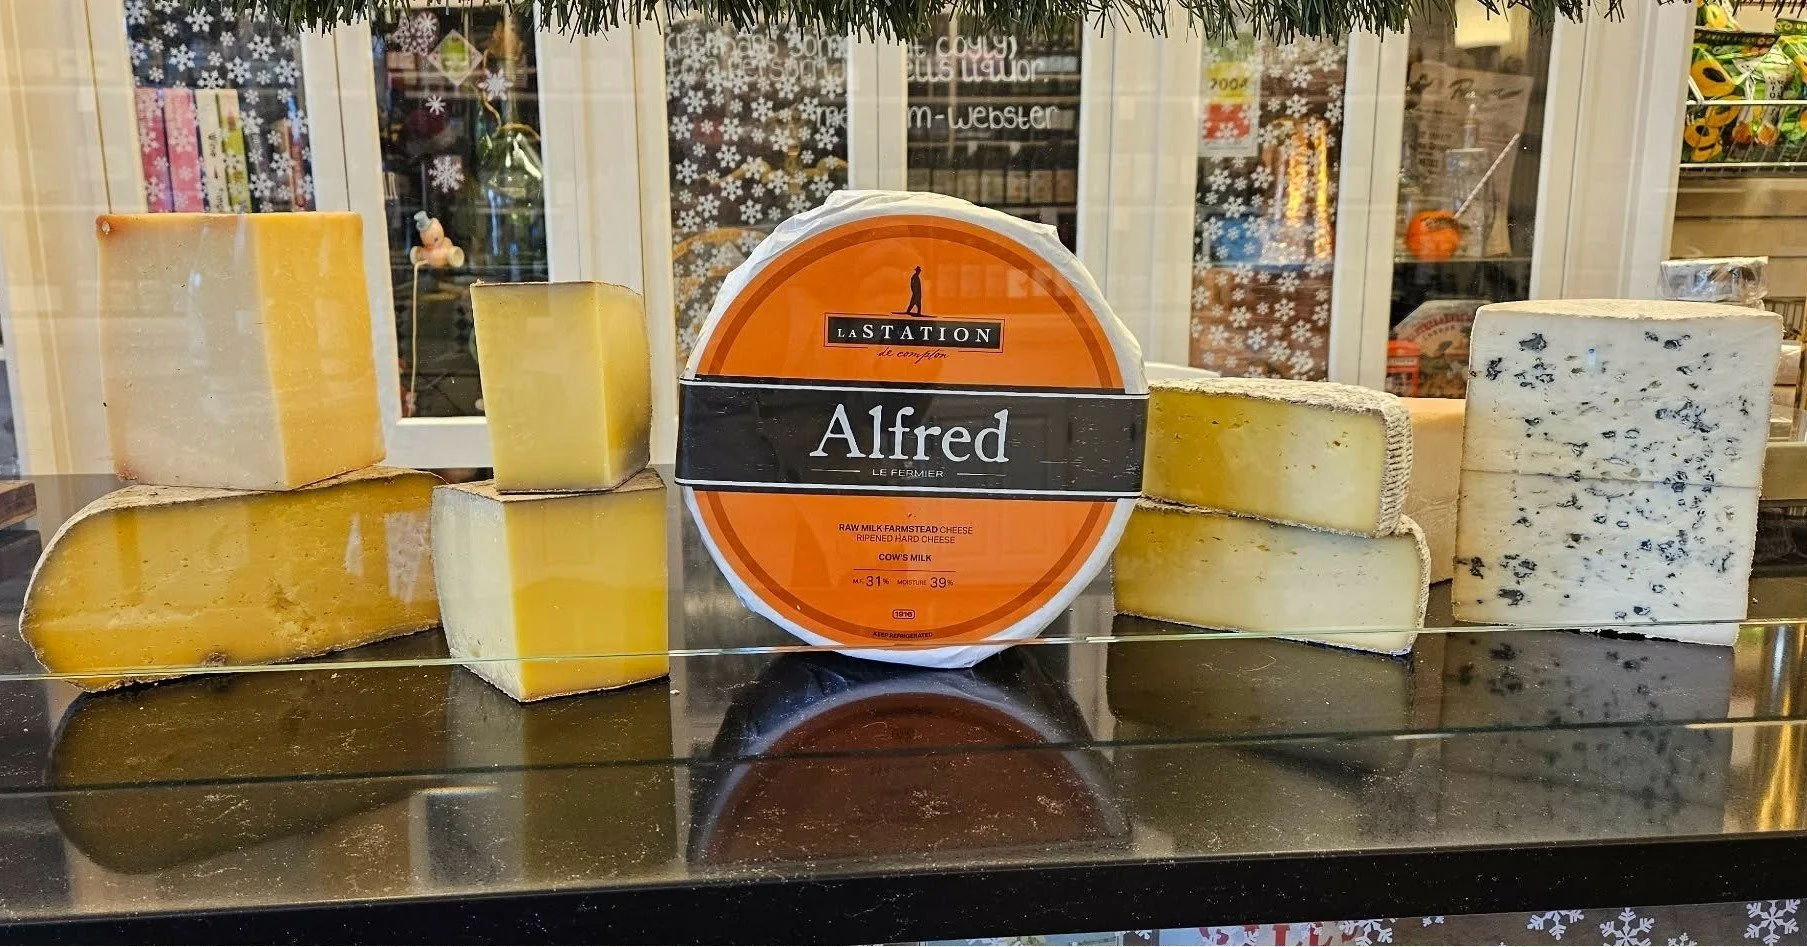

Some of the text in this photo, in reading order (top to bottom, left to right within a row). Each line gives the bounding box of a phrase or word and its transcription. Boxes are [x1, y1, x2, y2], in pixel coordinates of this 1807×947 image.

[862, 324, 992, 343] STATION
[809, 403, 1010, 463] Alfred
[872, 468, 944, 478] LE FERMIER
[839, 523, 973, 535] RAW MILK FARMSTEAD CHEESE
[856, 533, 956, 544] RIPENED HARD CHEESE
[878, 553, 932, 562] COW'S MILK
[889, 631, 933, 639] REFRIGERATED
